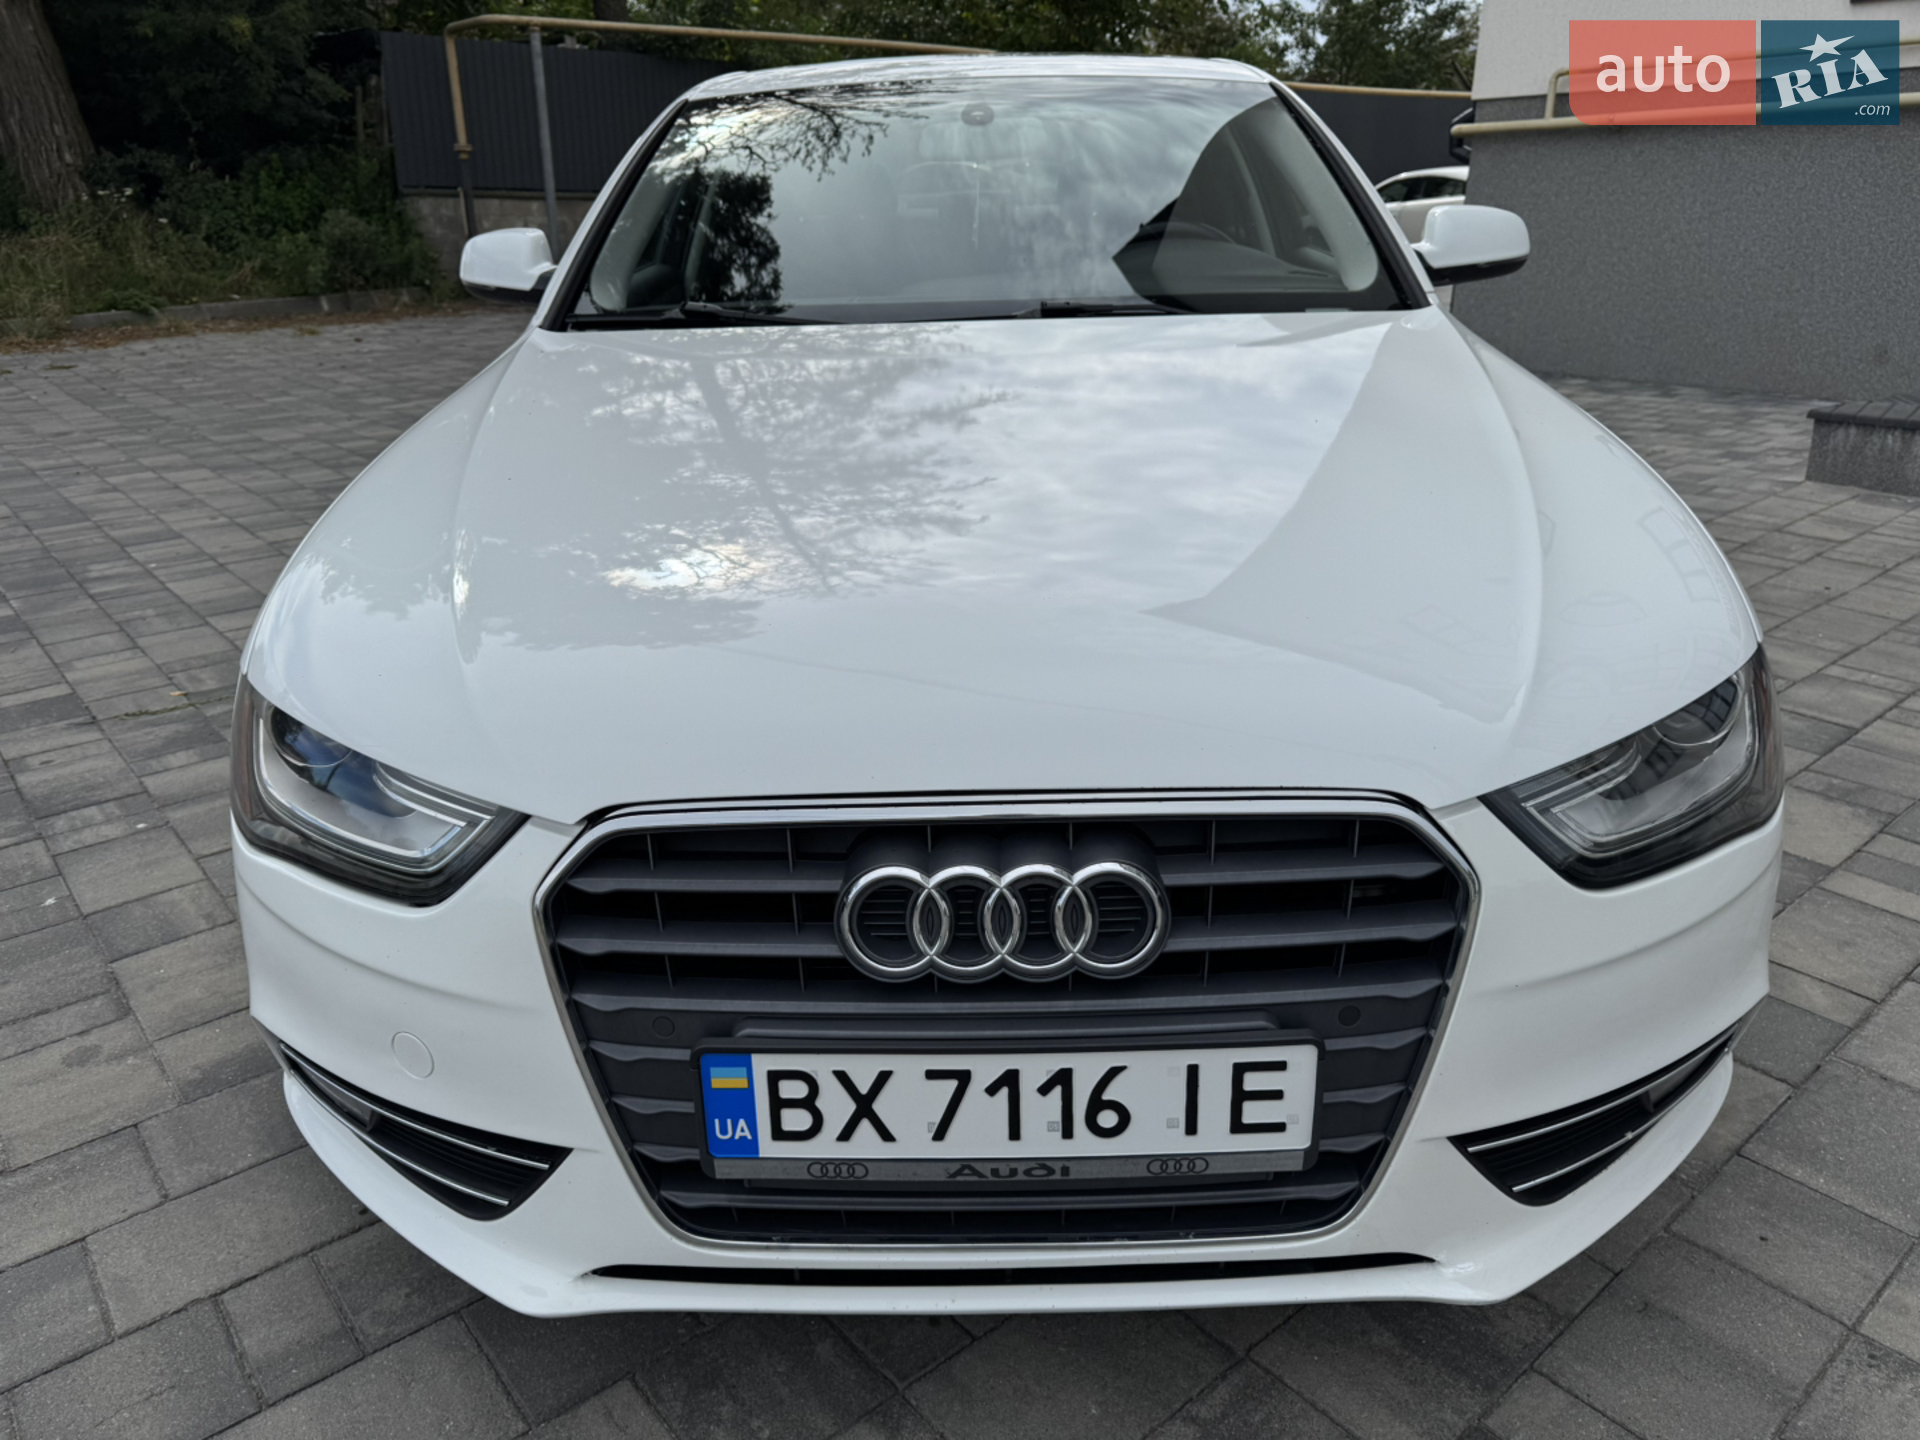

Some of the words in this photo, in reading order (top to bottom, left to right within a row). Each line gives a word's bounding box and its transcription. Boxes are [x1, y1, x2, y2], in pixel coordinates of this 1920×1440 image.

[767, 1070, 897, 1142] BX
[925, 1065, 1132, 1141] 7116
[1184, 1060, 1288, 1136] IE
[714, 1118, 752, 1140] UA
[946, 1163, 1071, 1179] Audi
